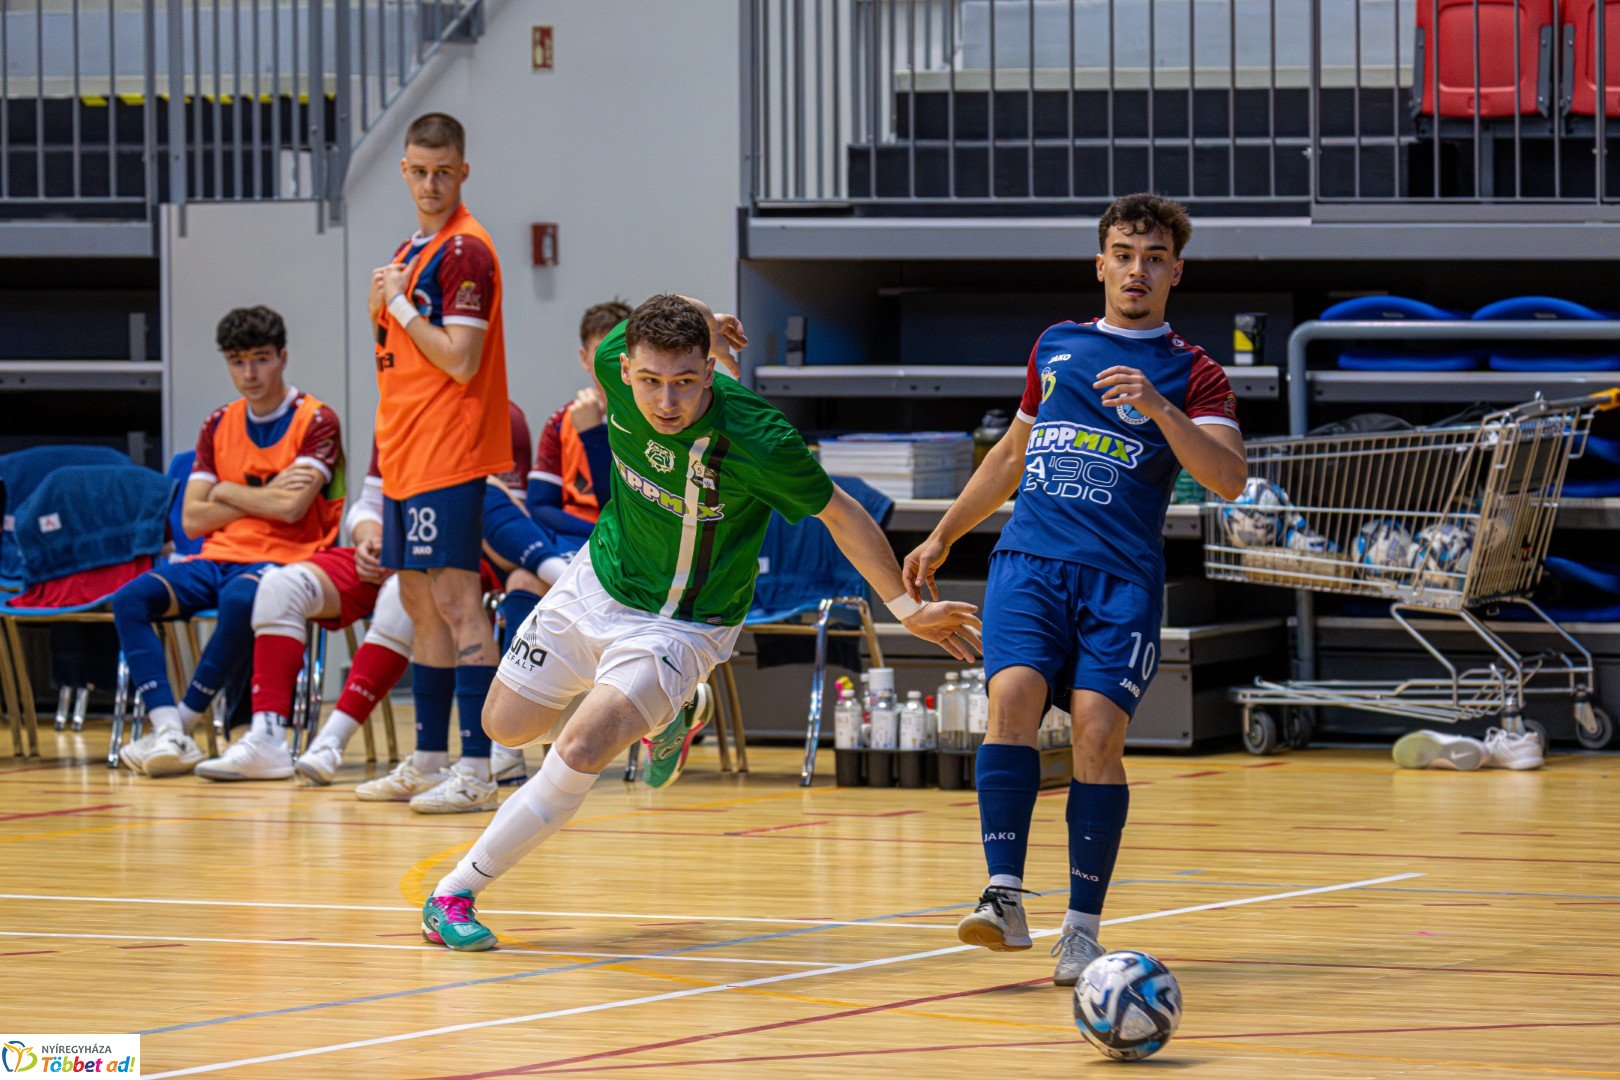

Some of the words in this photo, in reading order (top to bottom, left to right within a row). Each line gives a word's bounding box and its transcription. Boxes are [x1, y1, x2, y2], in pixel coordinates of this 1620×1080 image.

[1047, 353, 1072, 365] JAKO
[406, 506, 438, 543] 28
[1128, 631, 1156, 681] 10
[1119, 677, 1141, 698] JAKO
[983, 831, 1017, 843] JAKO
[1071, 866, 1100, 882] JAKO
